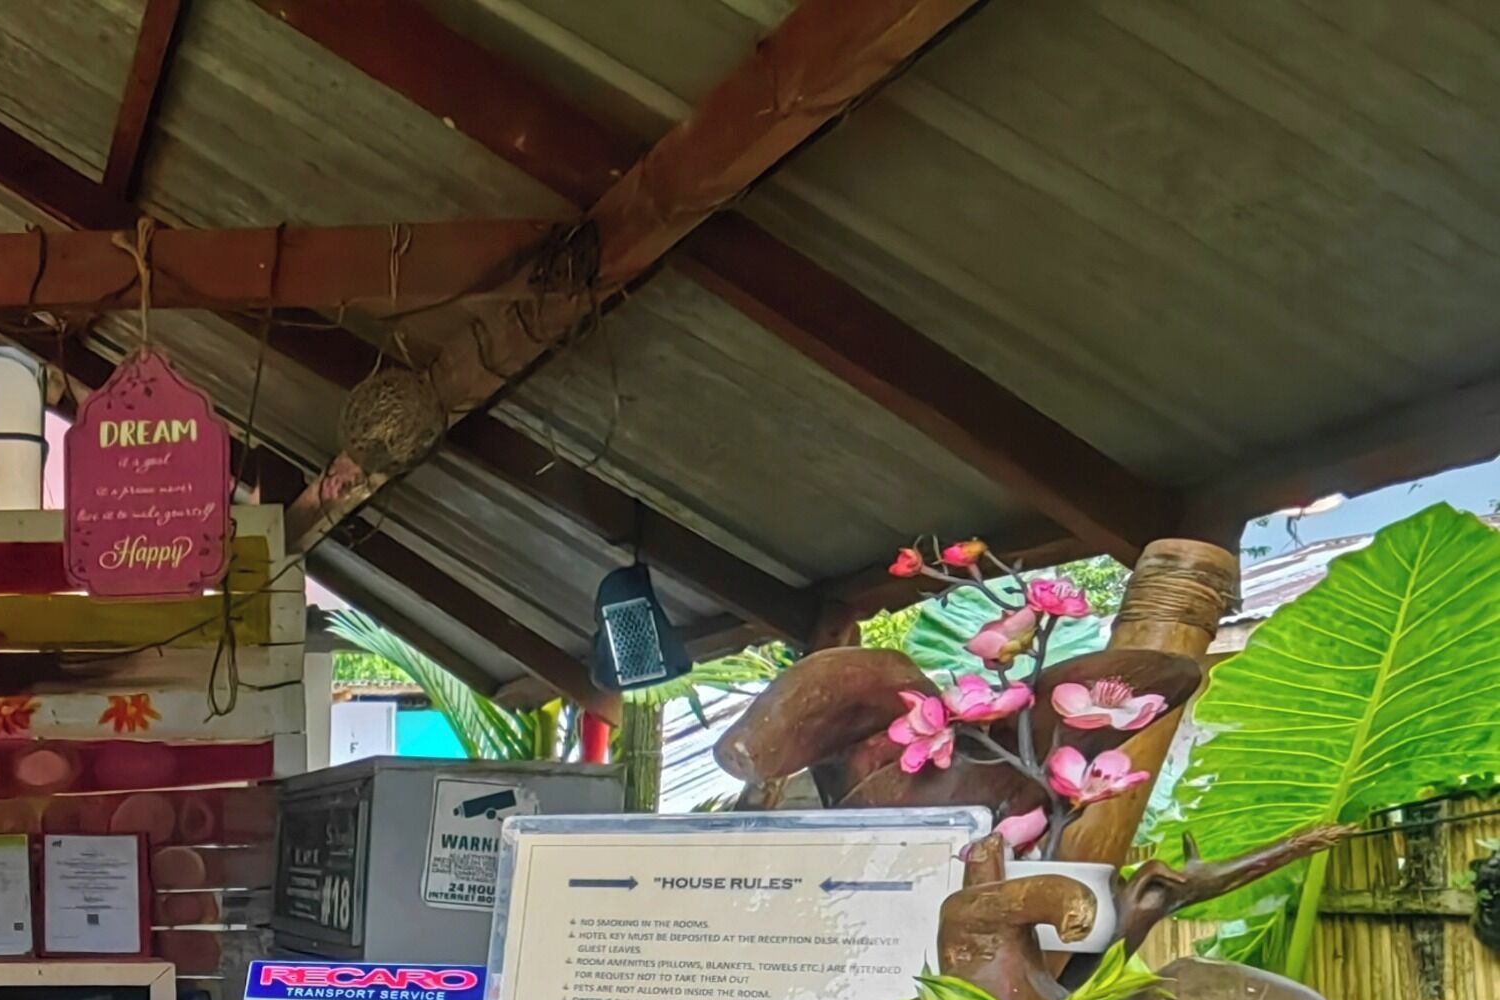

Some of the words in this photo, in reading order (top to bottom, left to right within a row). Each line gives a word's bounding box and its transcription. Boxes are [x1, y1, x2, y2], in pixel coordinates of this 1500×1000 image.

[100, 419, 198, 448] DREAM
[100, 534, 193, 569] Happy
[441, 833, 500, 853] WARNI
[448, 883, 464, 892] 24
[468, 884, 496, 895] HOU
[653, 876, 726, 890] "HOUSE
[730, 877, 802, 891] RULES"
[320, 873, 350, 931] #18
[596, 919, 639, 927] SMOKING
[654, 920, 670, 928] THE
[579, 932, 607, 940] HOTEL
[628, 933, 654, 941] MUST
[670, 934, 720, 942] DEPOSITED
[758, 936, 812, 944] RECEPTION
[576, 958, 605, 966] ROOM
[606, 959, 655, 968] AMENITIES
[758, 963, 798, 972] TOWELS
[827, 964, 846, 973] ARE
[260, 966, 478, 991] RECARO
[575, 971, 592, 979] FOR
[595, 971, 635, 980] REQUEST
[637, 973, 657, 981] NOT
[675, 974, 696, 982] TAKE
[700, 975, 727, 983] THEM
[286, 987, 376, 999] TRANSPORT
[379, 990, 445, 1000] SERVICE
